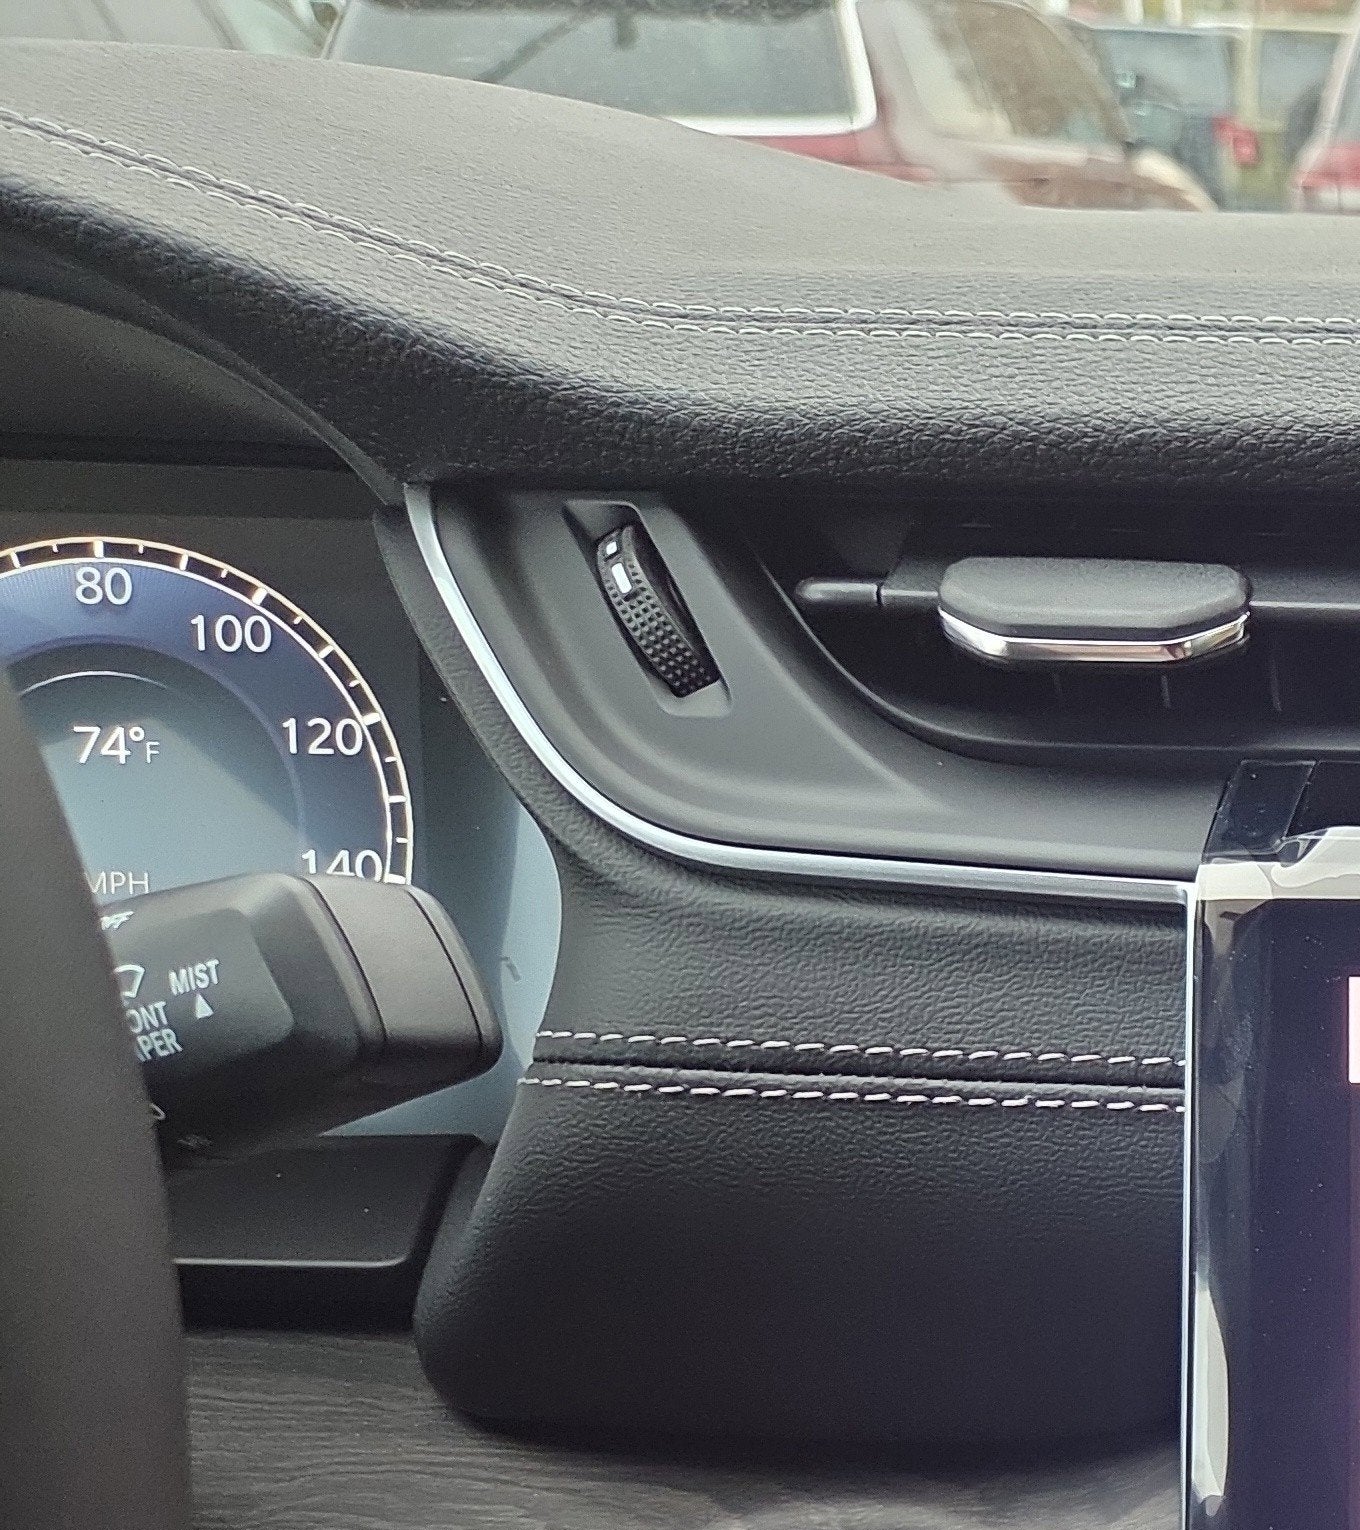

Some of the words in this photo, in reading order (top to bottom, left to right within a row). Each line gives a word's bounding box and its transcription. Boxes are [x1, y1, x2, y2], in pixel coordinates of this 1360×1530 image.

[75, 566, 133, 605] 80
[191, 614, 272, 653] 100
[283, 716, 364, 756] 120
[301, 848, 383, 884] 140
[168, 958, 220, 996] MIST
[126, 1001, 168, 1034] ONT
